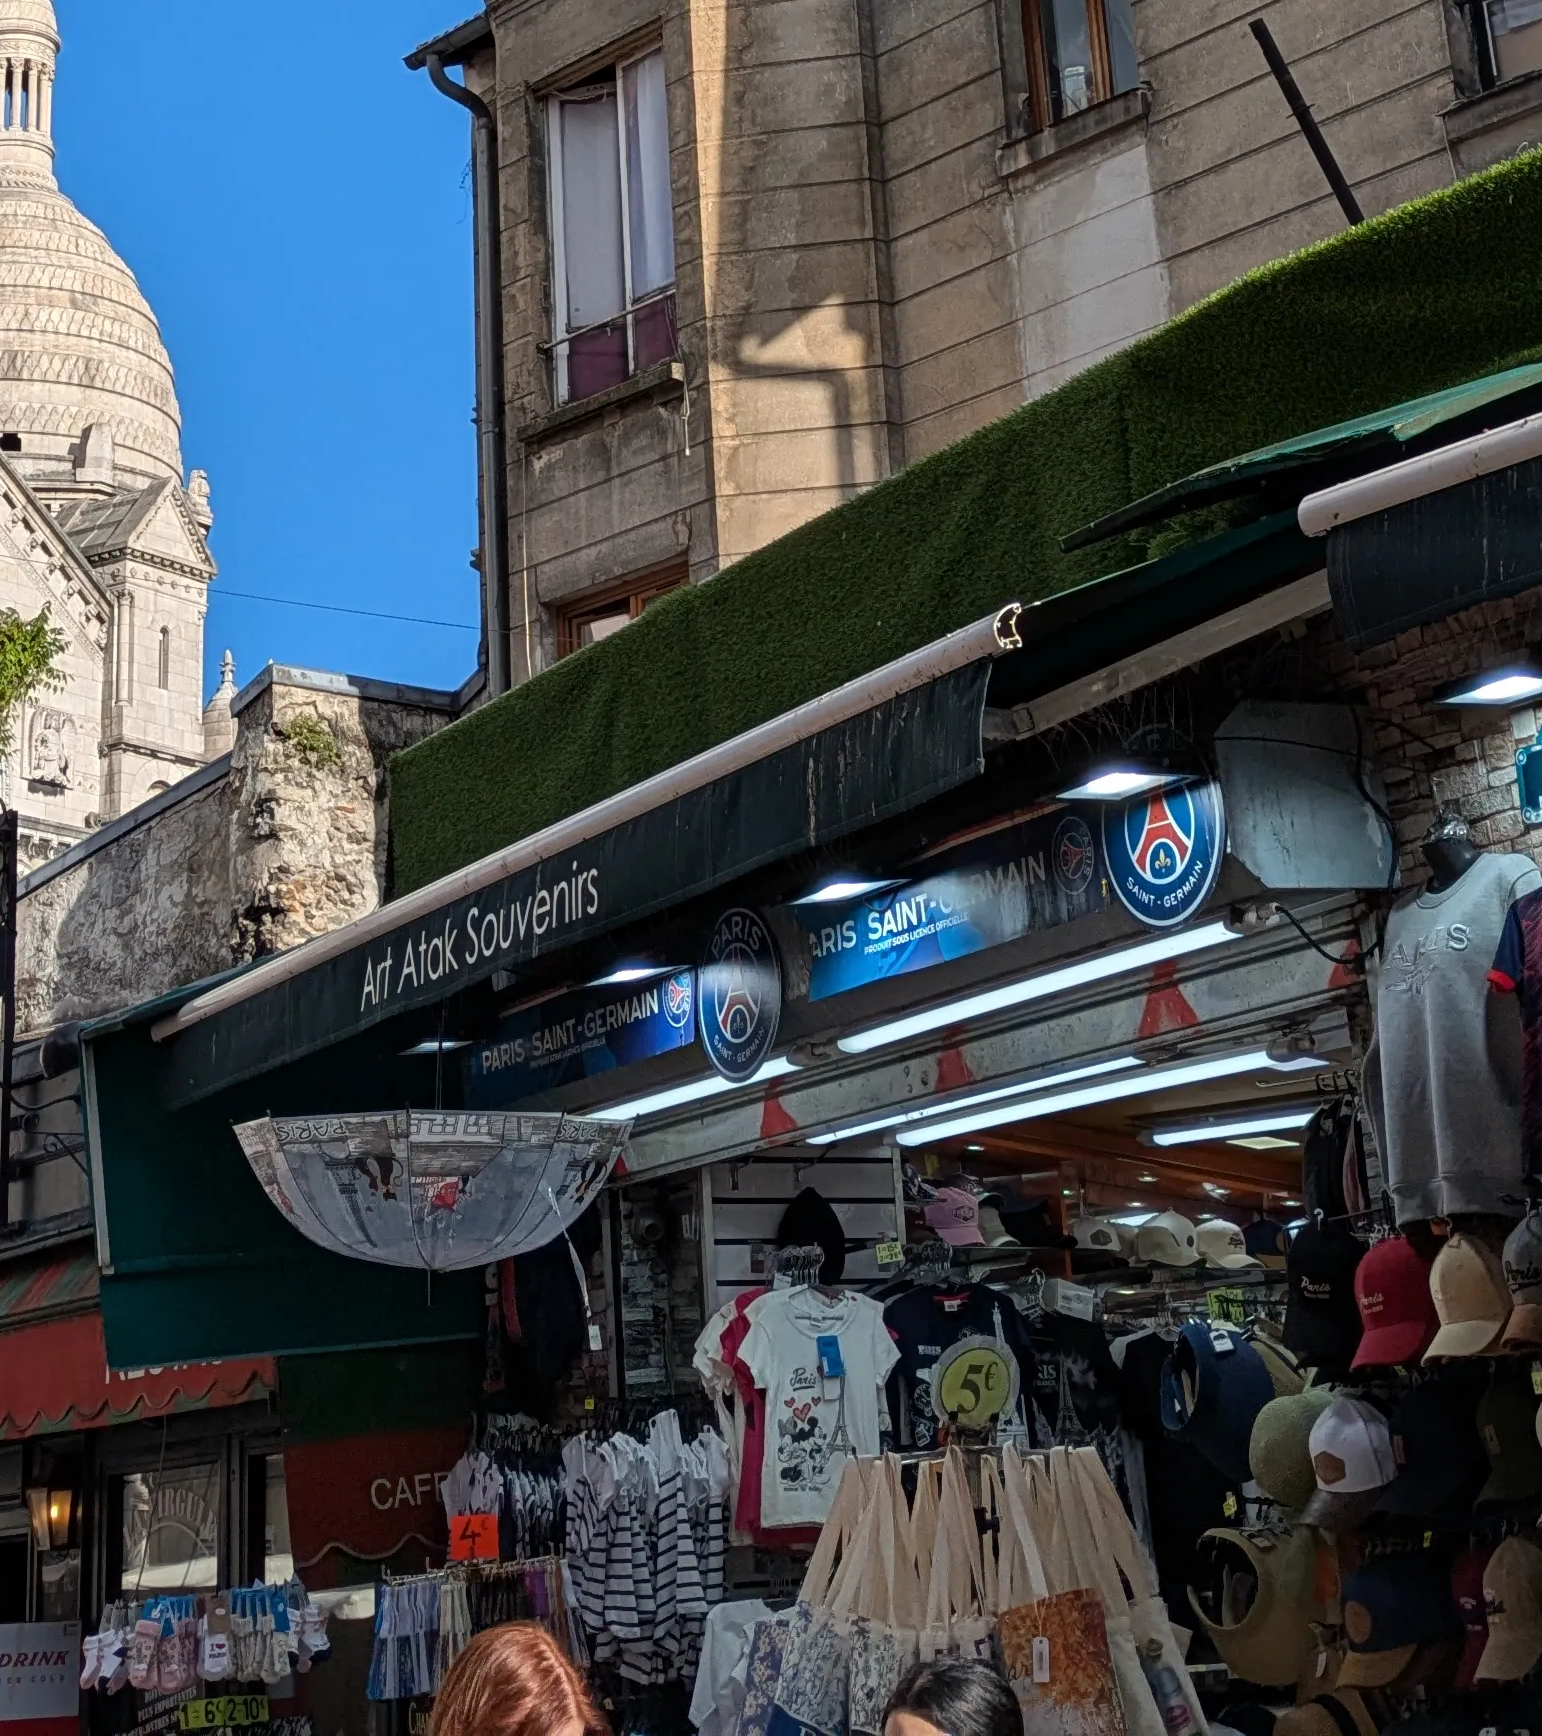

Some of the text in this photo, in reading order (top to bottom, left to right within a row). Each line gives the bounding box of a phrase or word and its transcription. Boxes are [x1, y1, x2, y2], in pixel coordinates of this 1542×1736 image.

[360, 861, 598, 1012] Art Atak Souvenirs
[711, 916, 762, 960] PARIS
[810, 920, 857, 958] ARIS
[481, 1039, 525, 1074] PARIS
[276, 1119, 349, 1143] PARIS
[1300, 1275, 1331, 1292] Paris
[790, 1368, 817, 1387] Paris
[0, 1674, 65, 1685] ICE COLD
